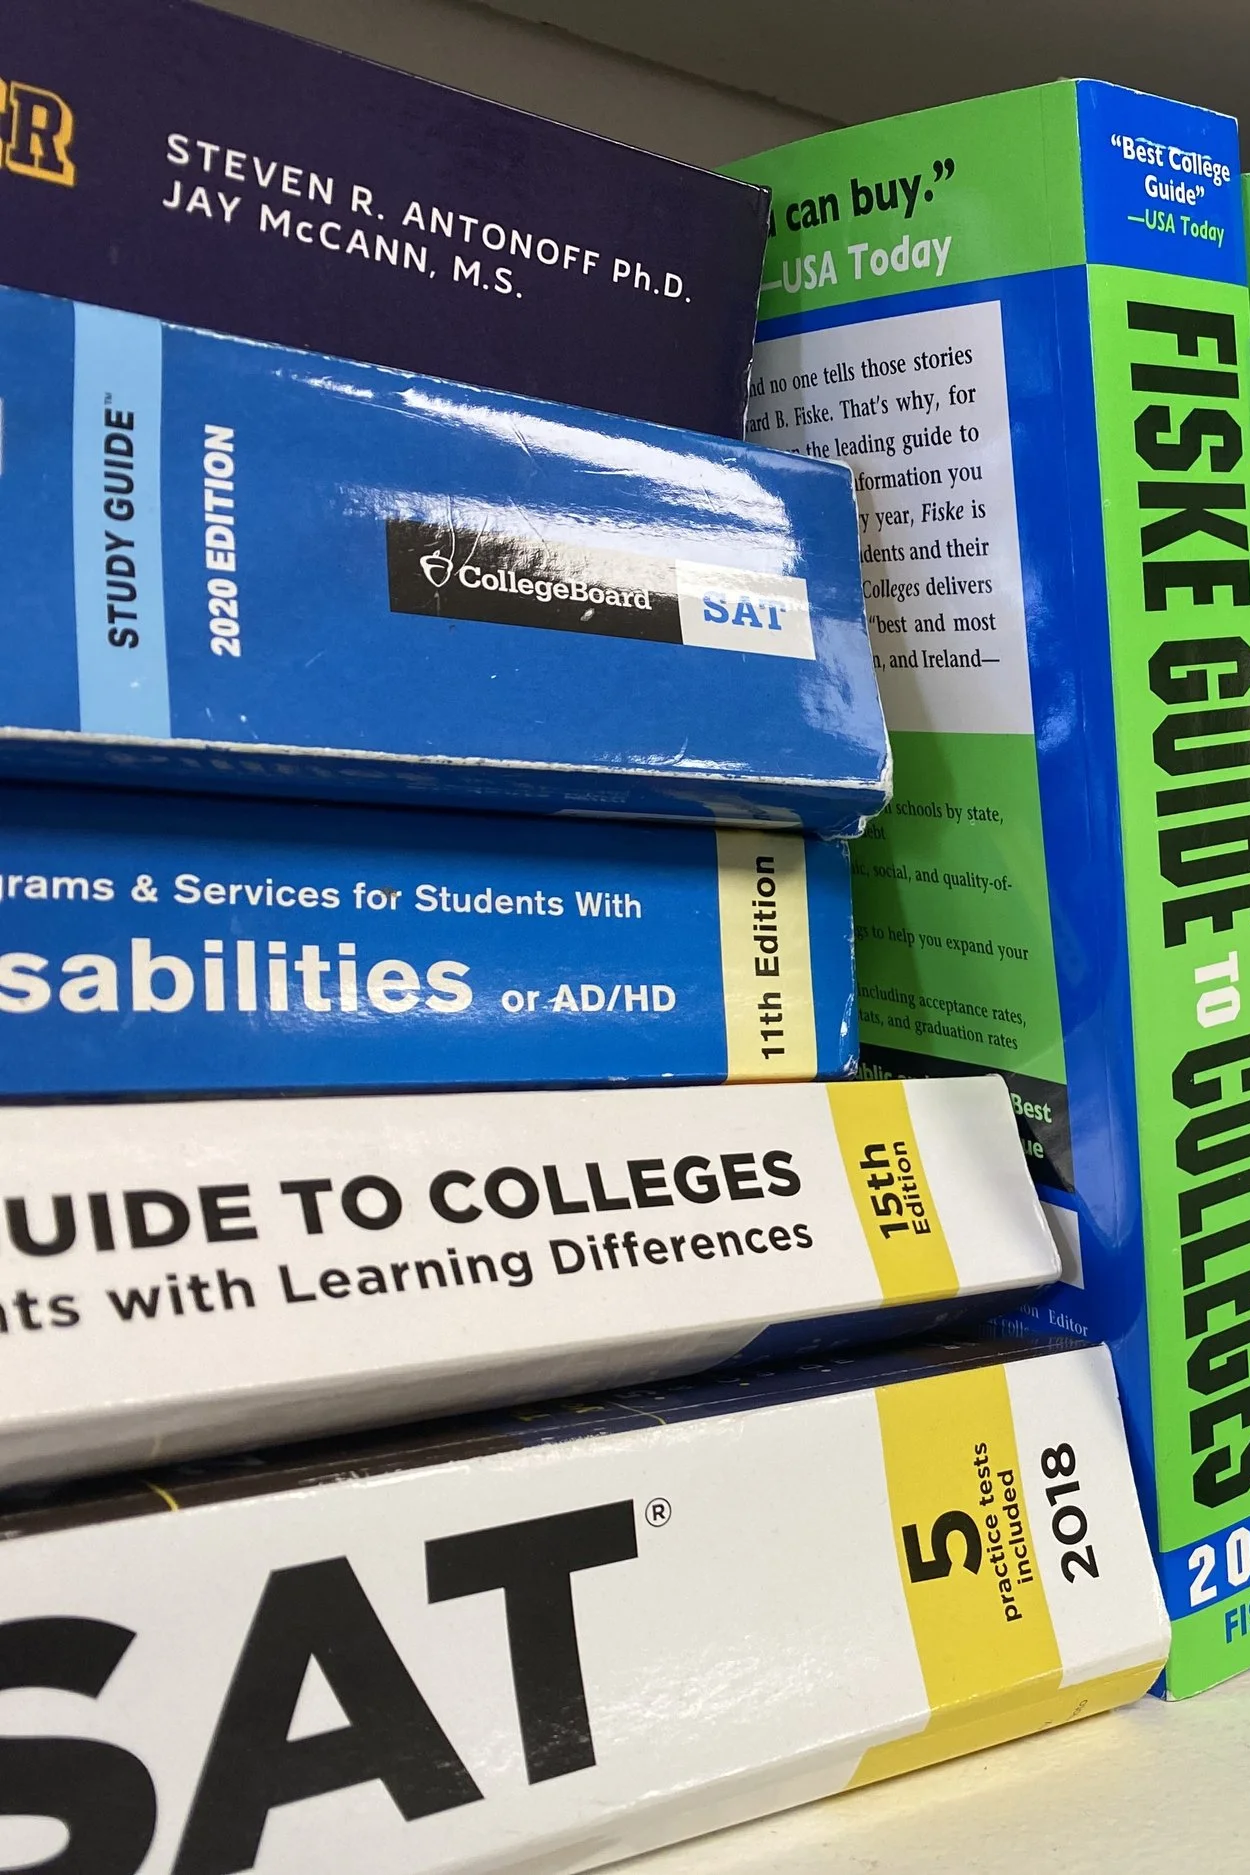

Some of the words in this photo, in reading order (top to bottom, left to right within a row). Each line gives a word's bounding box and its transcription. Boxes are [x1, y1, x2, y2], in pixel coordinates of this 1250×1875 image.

[1110, 133, 1164, 168] “Best
[1167, 145, 1231, 187] College
[785, 192, 840, 232] can
[849, 157, 956, 220] buy.”
[1143, 174, 1206, 206] Guide”
[162, 180, 242, 223] JAY
[258, 203, 437, 280] McCANN,
[452, 254, 524, 300] M.S.
[166, 133, 334, 205] STEVEN
[351, 184, 386, 221] R.
[401, 200, 600, 275] ANTONOFF
[611, 257, 692, 303] Ph.D.
[1180, 215, 1226, 249] Today
[847, 234, 953, 280] Today
[770, 377, 788, 394] no
[792, 371, 819, 390] one
[823, 361, 856, 385] tells
[860, 356, 908, 380] those
[913, 346, 974, 372] stories
[745, 412, 771, 434] ard
[775, 410, 790, 430] B.
[794, 403, 835, 427] Fiske.
[838, 394, 890, 421] That's
[895, 389, 941, 416] why,
[948, 384, 977, 407] for
[805, 438, 831, 460] the
[834, 432, 897, 458] leading
[901, 424, 953, 456] guide
[959, 424, 980, 443] to
[203, 423, 237, 573] EDITION
[947, 464, 983, 490] you
[875, 509, 915, 533] year,
[920, 500, 965, 524] Fiske
[971, 498, 987, 520] is
[909, 539, 942, 561] and
[945, 537, 990, 559] their
[104, 529, 140, 650] STUDY
[457, 563, 653, 612] CollegeBoard
[702, 590, 787, 632] SAT
[862, 578, 921, 603] Colleges
[925, 575, 993, 597] delivers
[206, 577, 242, 658] 2020
[868, 613, 908, 635] “best
[914, 612, 946, 633] and
[953, 612, 997, 632] most
[889, 649, 919, 669] and
[895, 799, 943, 819] schools
[946, 802, 963, 825] by
[966, 805, 1005, 826] state,
[0, 873, 115, 903] rams
[130, 873, 159, 903] &
[173, 872, 341, 910] Services
[352, 881, 402, 911] for
[414, 883, 565, 917] Students
[574, 890, 643, 919] With
[872, 863, 913, 885] social,
[914, 867, 940, 884] and
[942, 871, 1014, 895] quality-of-
[751, 855, 781, 978] Edition
[872, 924, 885, 940] to
[887, 925, 916, 949] help
[918, 931, 943, 950] you
[945, 935, 995, 956] expand
[997, 942, 1030, 962] your
[500, 988, 541, 1013] or
[552, 983, 677, 1013] AD/HD
[918, 995, 989, 1019] acceptance
[991, 1006, 1027, 1028] rates,
[1193, 950, 1242, 1030] TO
[756, 991, 786, 1060] 11th
[887, 1013, 912, 1031] and
[914, 1018, 985, 1044] graduation
[987, 1031, 1019, 1051] rates
[1010, 1091, 1053, 1124] Best
[4, 1182, 260, 1258] UIDE
[278, 1173, 404, 1236] TO
[428, 1149, 802, 1225] COLLEGES
[859, 1141, 911, 1241] 15th
[891, 1139, 932, 1237] Edition
[0, 1287, 82, 1334] ts
[106, 1267, 256, 1322] with
[277, 1246, 534, 1305] Learning
[548, 1221, 815, 1277] Differences
[1048, 1307, 1090, 1338] Editor
[973, 1441, 996, 1508] tests
[996, 1468, 1034, 1586] included
[1040, 1441, 1101, 1585] 2018
[900, 1509, 983, 1585] 5
[985, 1512, 1024, 1623] practice
